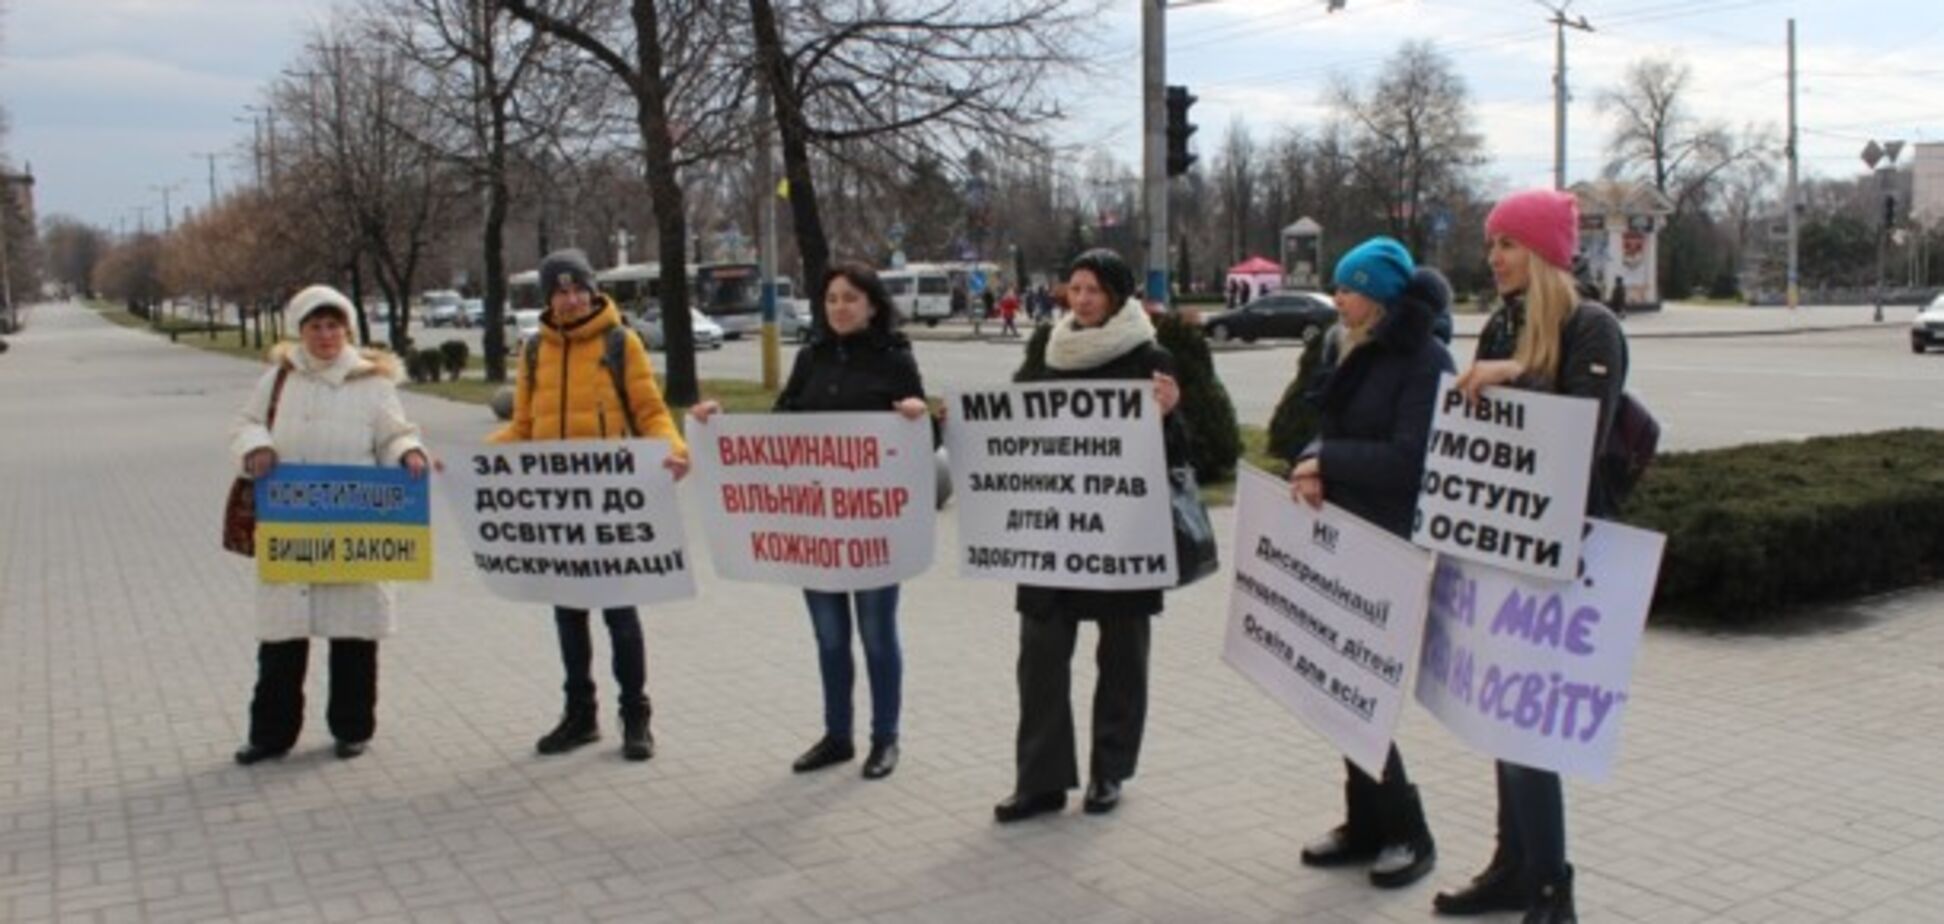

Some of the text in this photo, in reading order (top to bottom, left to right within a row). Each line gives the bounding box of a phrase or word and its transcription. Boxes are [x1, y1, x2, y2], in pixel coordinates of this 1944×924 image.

[961, 388, 1143, 421] МИ ПРОТИ
[1443, 389, 1525, 431] РІВНІ
[473, 448, 635, 475] ЗА РІВНИЙ
[718, 436, 880, 471] ВАКЦИНАЦІЯ
[987, 436, 1122, 457] ПОРУШЕННЯ
[476, 488, 645, 514] ДОСТУП ДО
[722, 480, 909, 519] ВІЛЬНИЙ ВИБІР
[969, 473, 1147, 497] ЗАКОННИХ ПРАВ
[1424, 471, 1551, 520] ОСТУПУ
[480, 522, 655, 544] ОСВІТИ БЕЗ
[1006, 507, 1104, 533] ДІТЕЙ НА
[268, 534, 417, 567] ВИЩІЙ ЗАКОН!
[751, 532, 890, 568] КОЖНОГО!!!
[1430, 514, 1562, 568] ОСВІТИ
[968, 546, 1167, 575] ЗДОБУТТЯ ОСВІТИ
